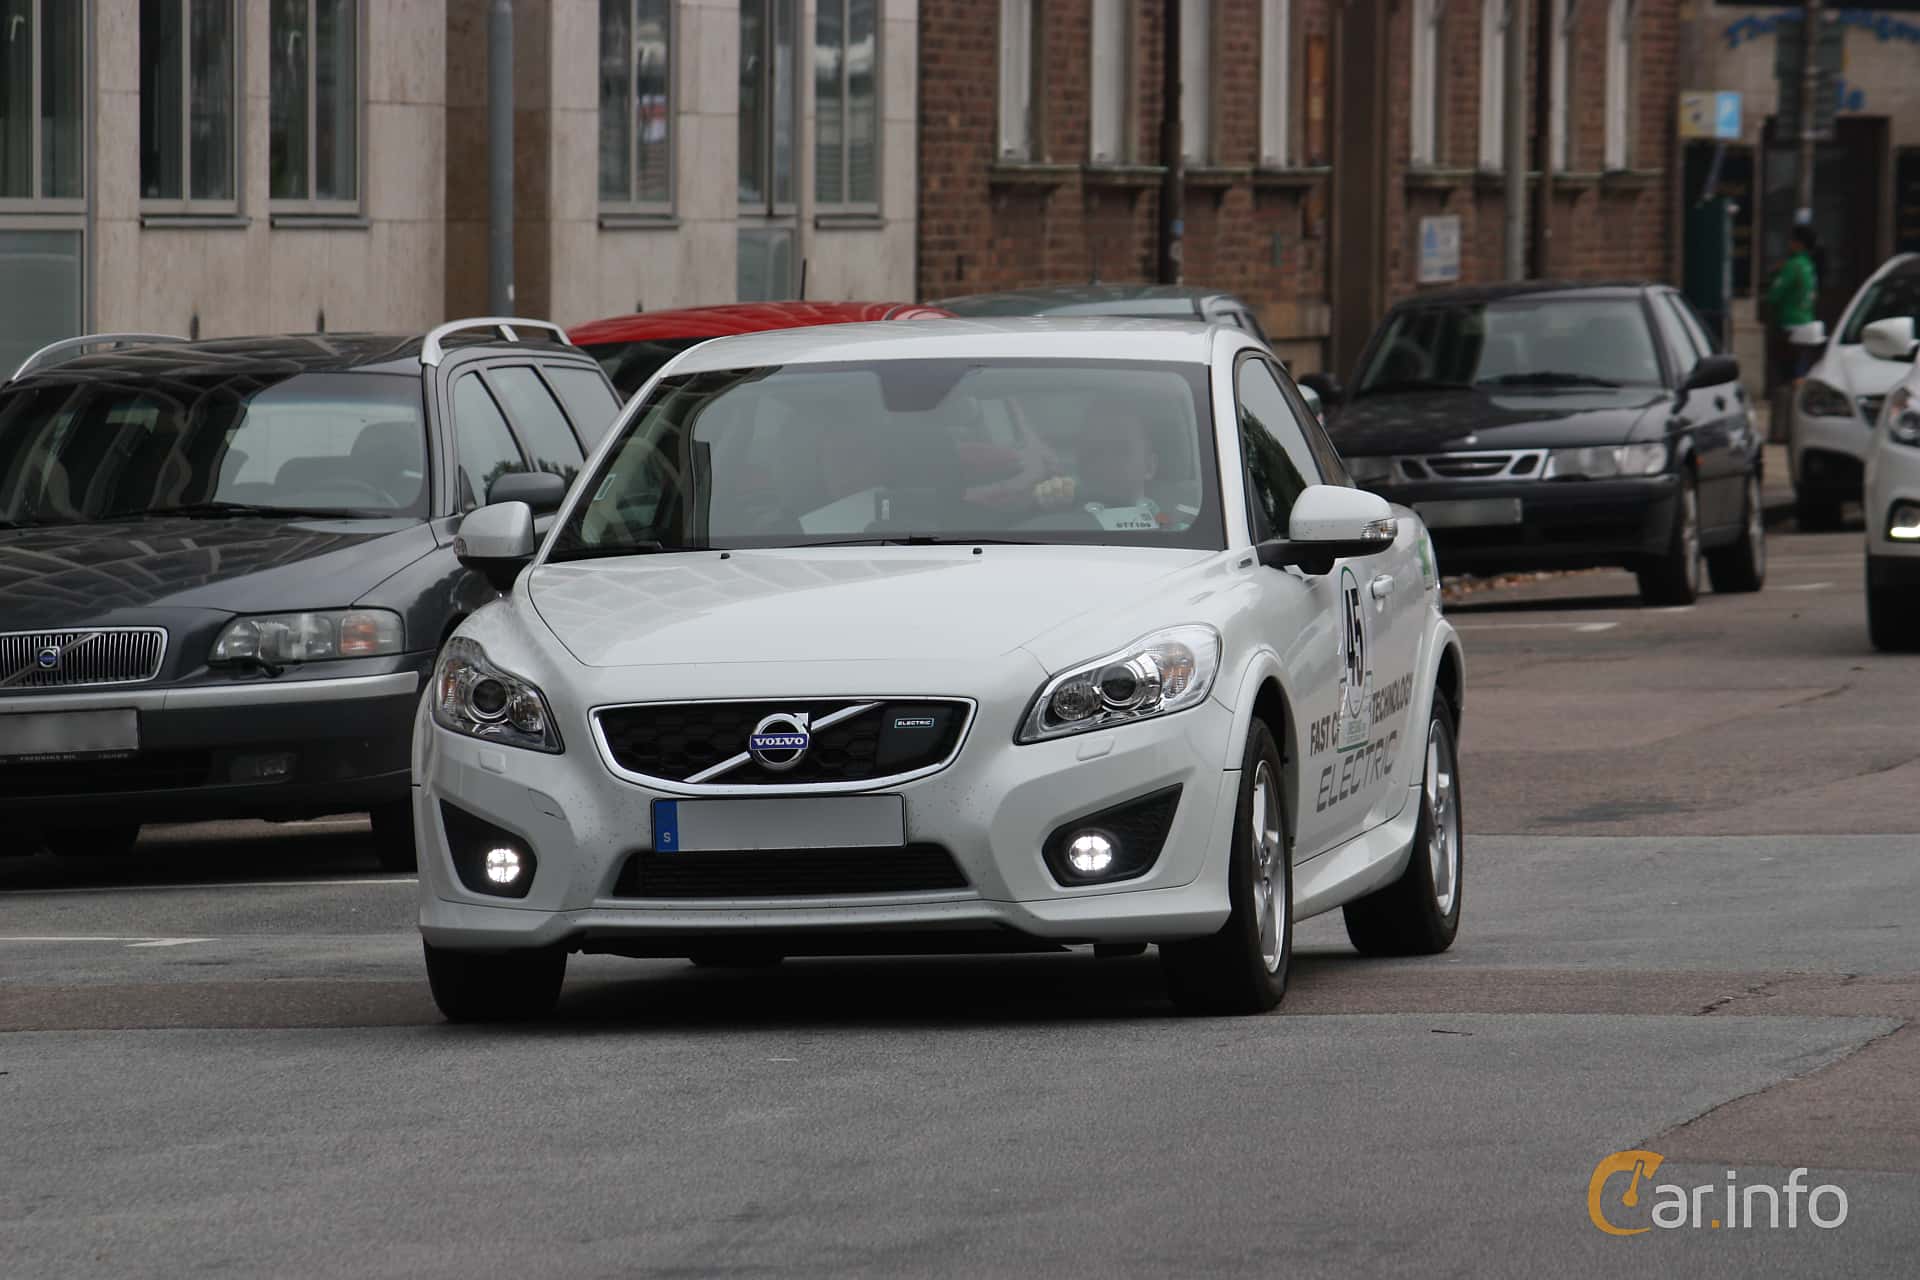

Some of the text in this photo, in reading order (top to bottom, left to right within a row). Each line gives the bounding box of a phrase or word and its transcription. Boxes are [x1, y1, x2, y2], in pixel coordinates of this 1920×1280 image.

[897, 719, 932, 727] ELECTRIC
[753, 736, 805, 747] VOLVO
[1310, 714, 1332, 757] FAST
[1316, 730, 1398, 813] ELECTRIC
[662, 831, 672, 844] S
